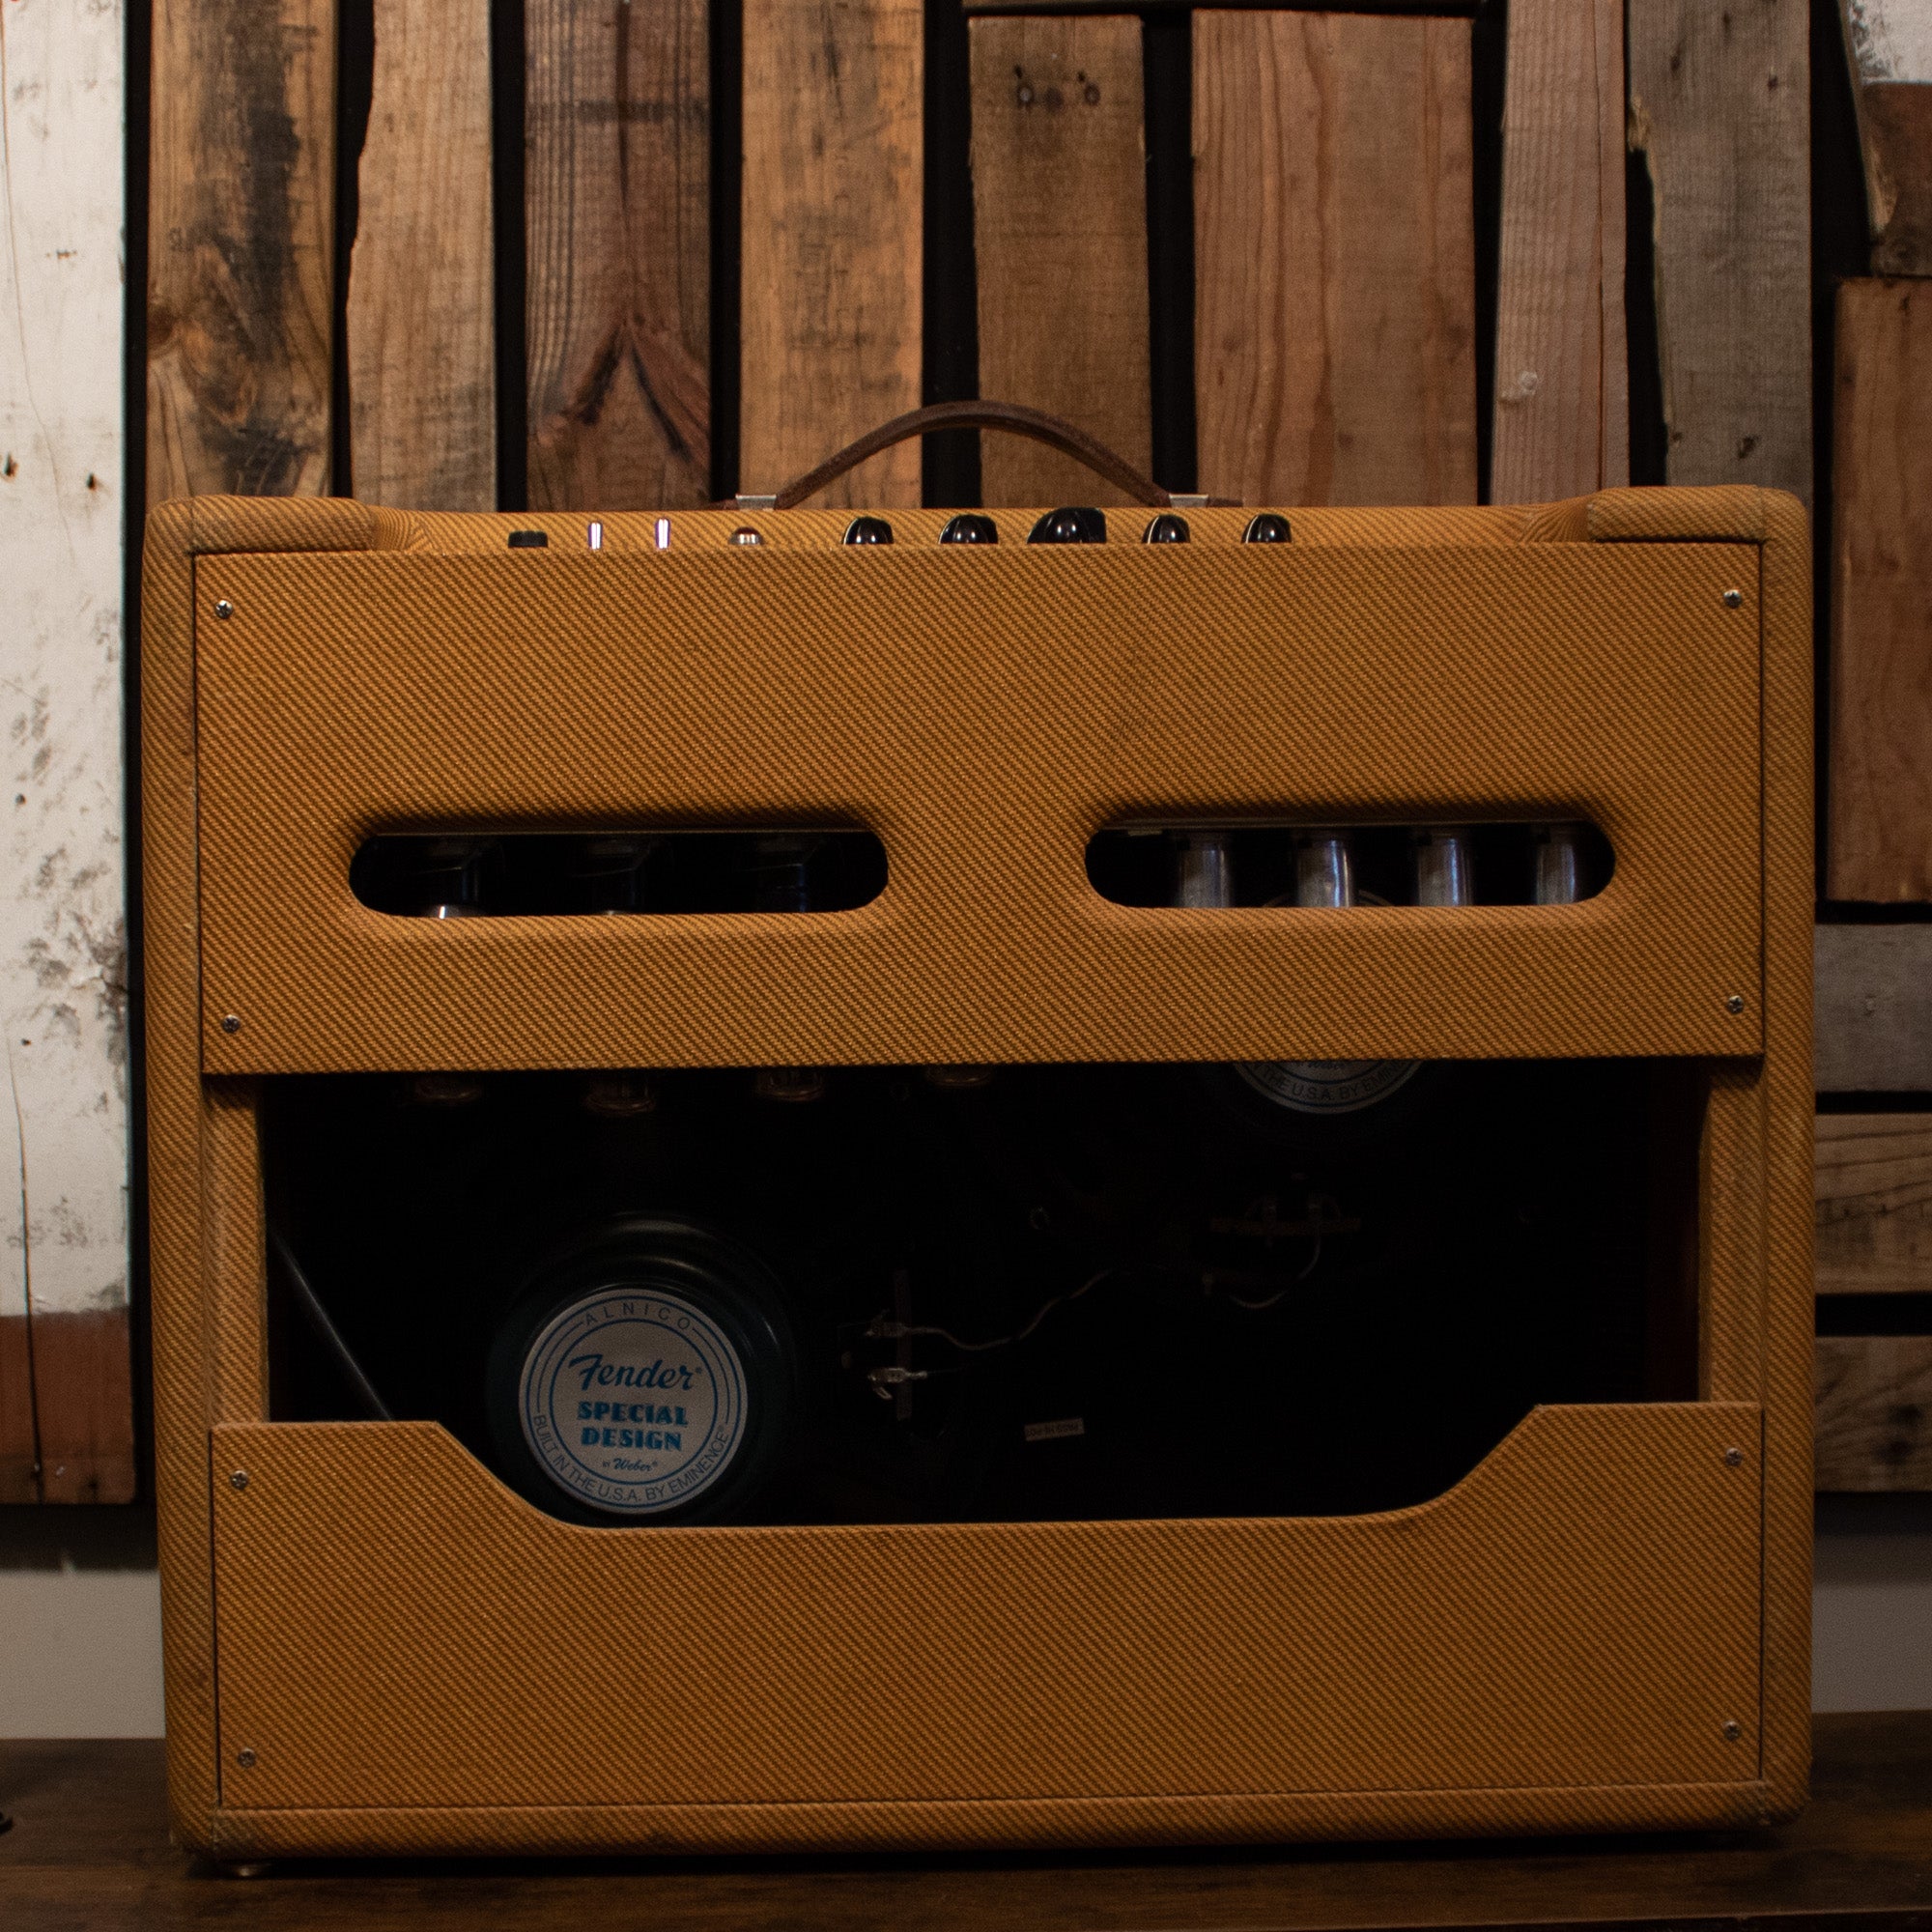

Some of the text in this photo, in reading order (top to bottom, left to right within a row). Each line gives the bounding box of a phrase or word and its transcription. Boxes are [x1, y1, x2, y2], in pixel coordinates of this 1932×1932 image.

[583, 1302, 692, 1330] ALNICO
[568, 1353, 695, 1391] Fender
[577, 1402, 688, 1427] SPECIAL
[581, 1427, 682, 1451] DESIGN
[533, 1414, 729, 1503] BUILT IN THE U.S.A. BY EMINENCE
[612, 1458, 652, 1471] Weber
